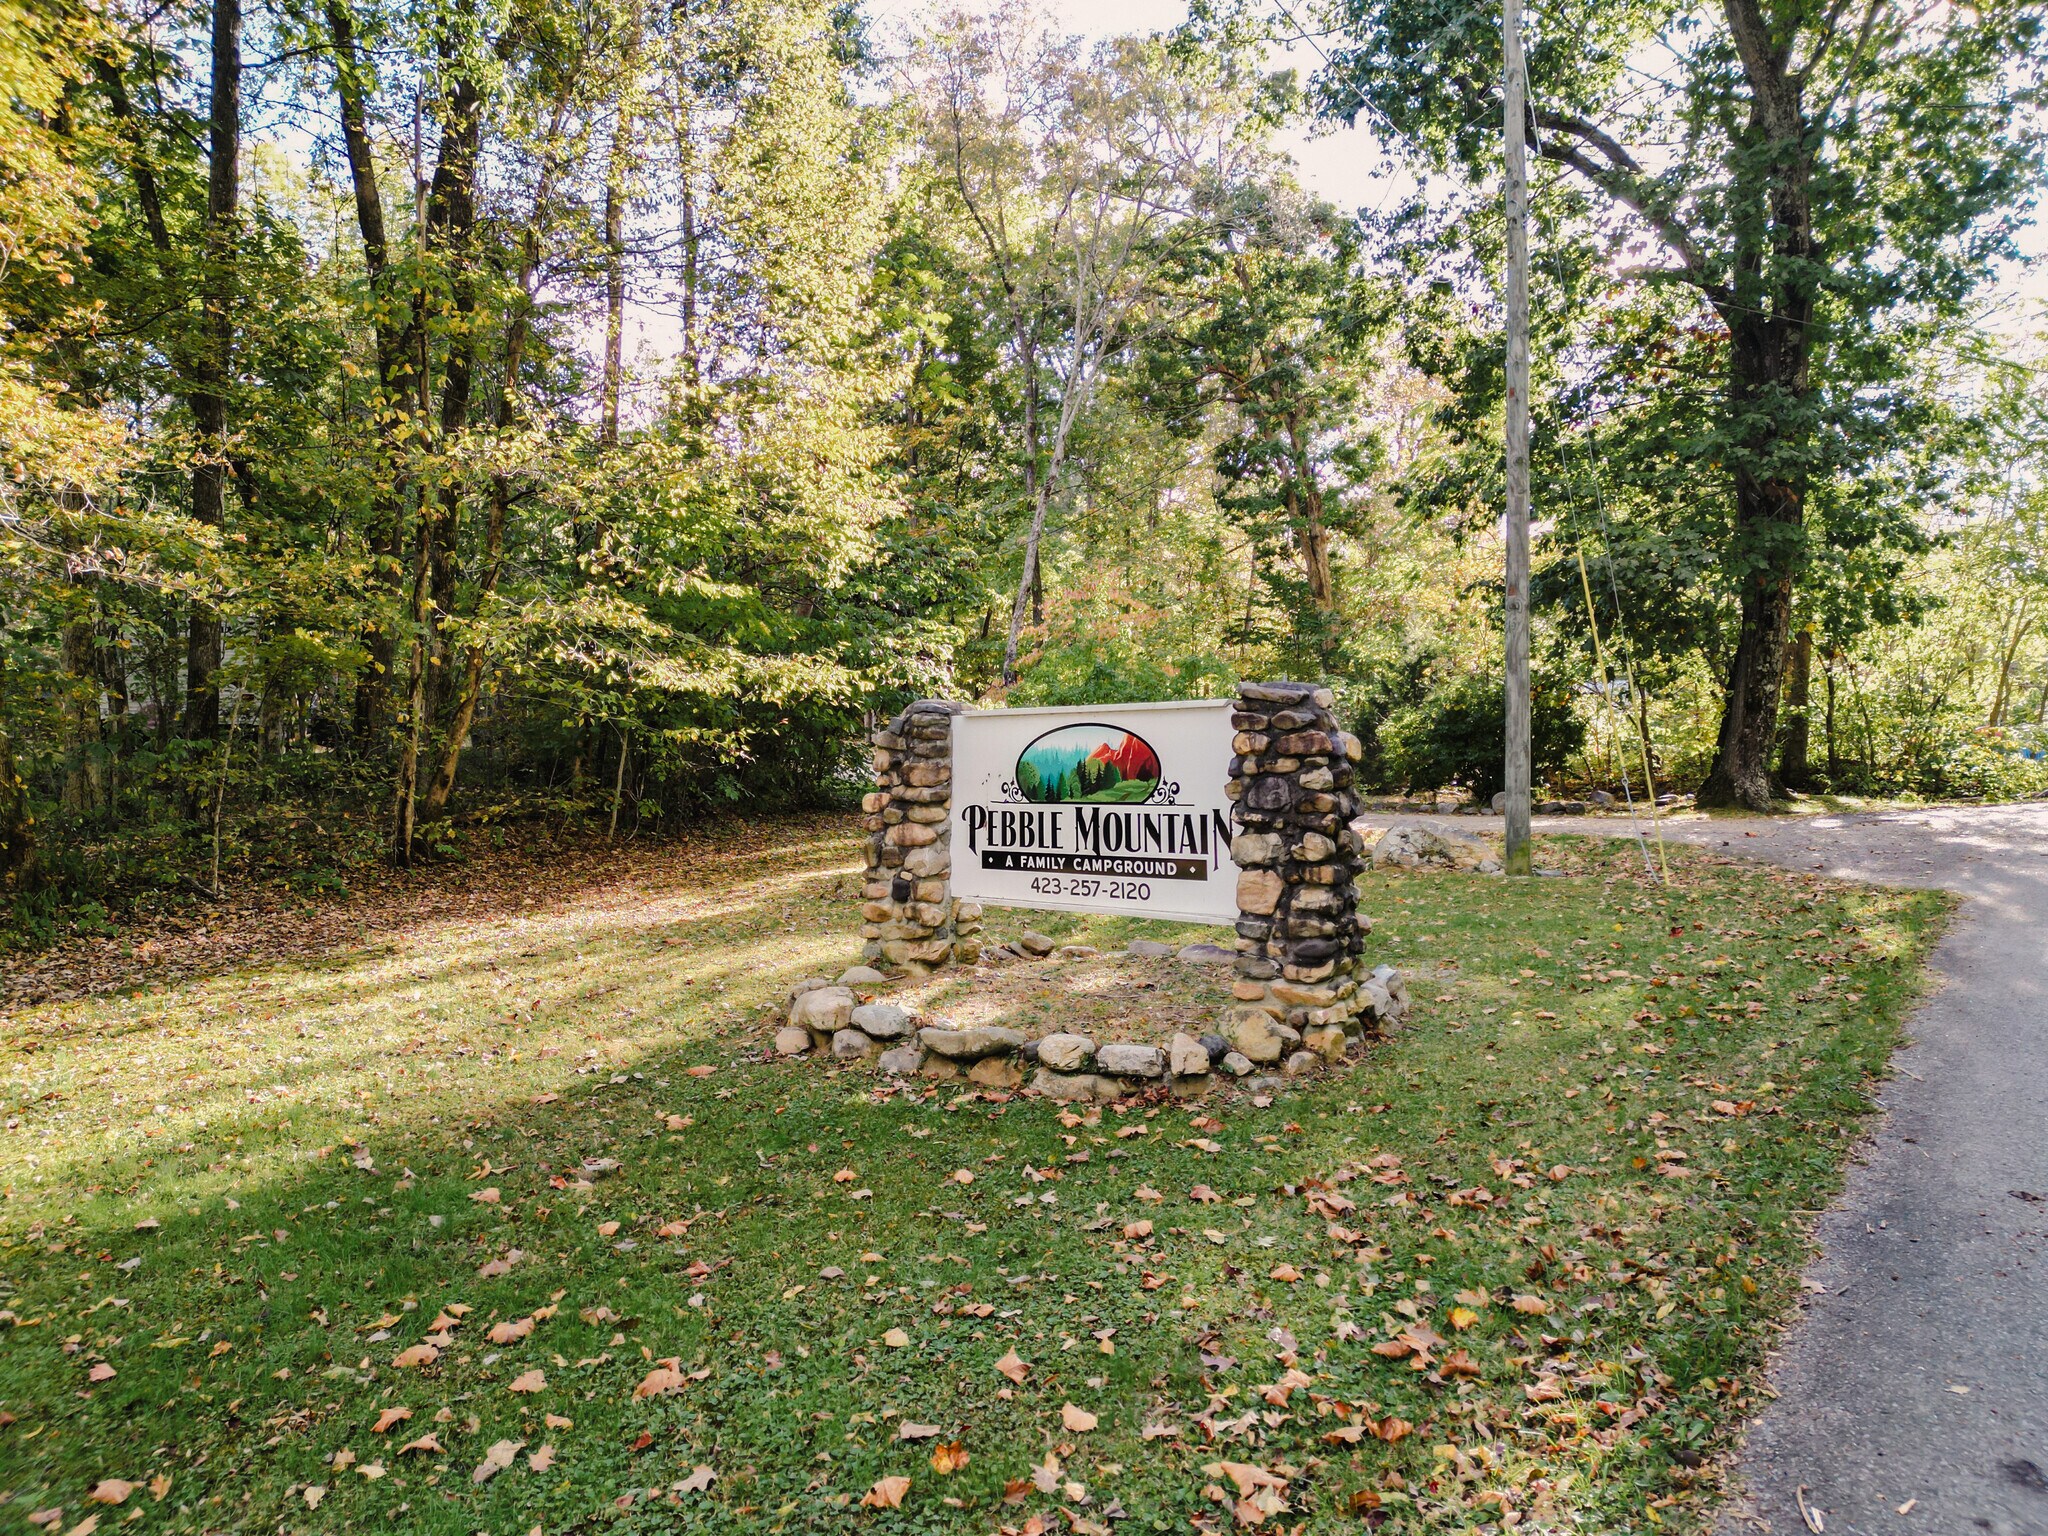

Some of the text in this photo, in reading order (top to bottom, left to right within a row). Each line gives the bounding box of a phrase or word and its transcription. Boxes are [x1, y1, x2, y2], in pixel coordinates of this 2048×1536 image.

[962, 804, 1234, 871] PEBBLE MOUNTAIN
[1005, 855, 1177, 875] A FAMILY CAMPGROUND
[1030, 877, 1151, 900] 423-257-2120
